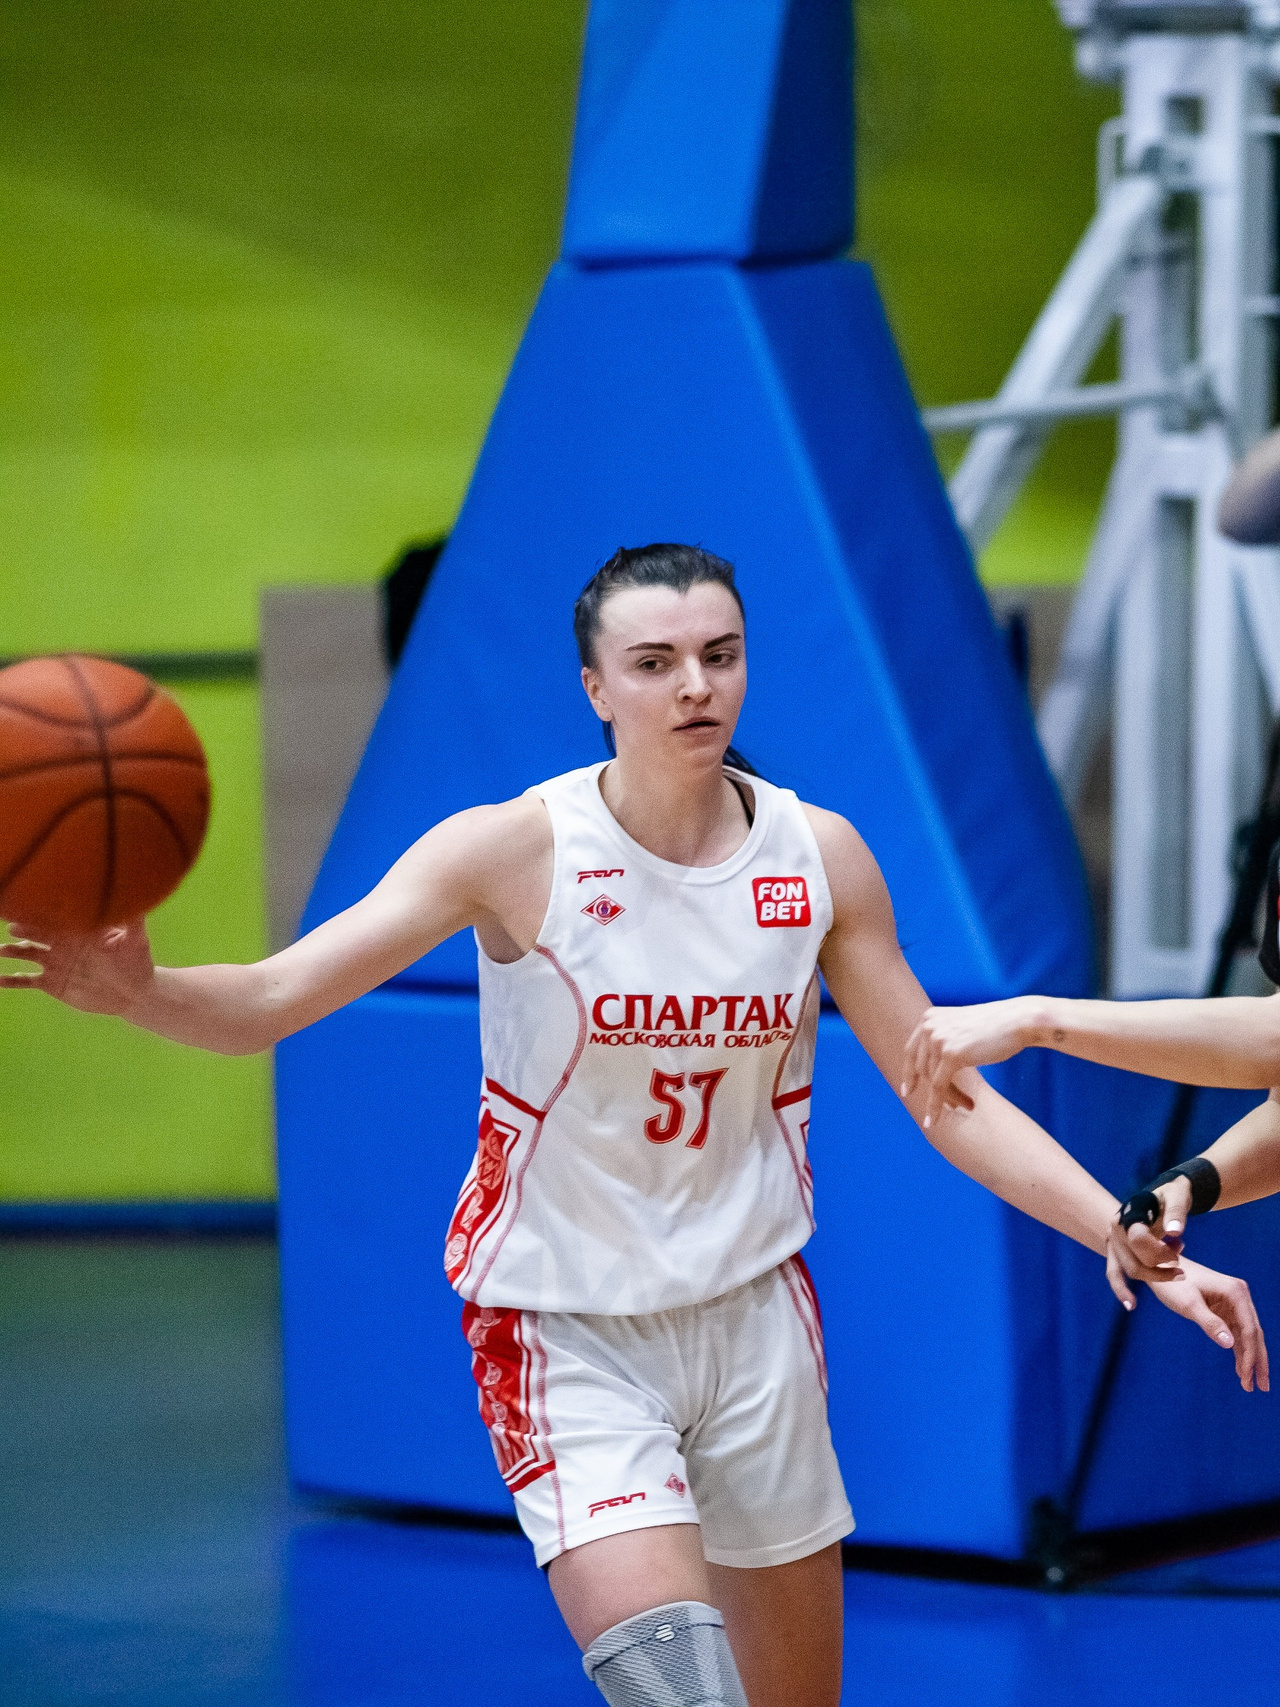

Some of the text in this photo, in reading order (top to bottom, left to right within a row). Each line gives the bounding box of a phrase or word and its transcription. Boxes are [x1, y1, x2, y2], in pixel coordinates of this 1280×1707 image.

[757, 881, 804, 901] FON
[760, 901, 807, 921] BET
[592, 993, 795, 1032] СПАРТАК
[588, 1031, 717, 1049] МОСКОВСКАЯ
[643, 1067, 730, 1150] 57
